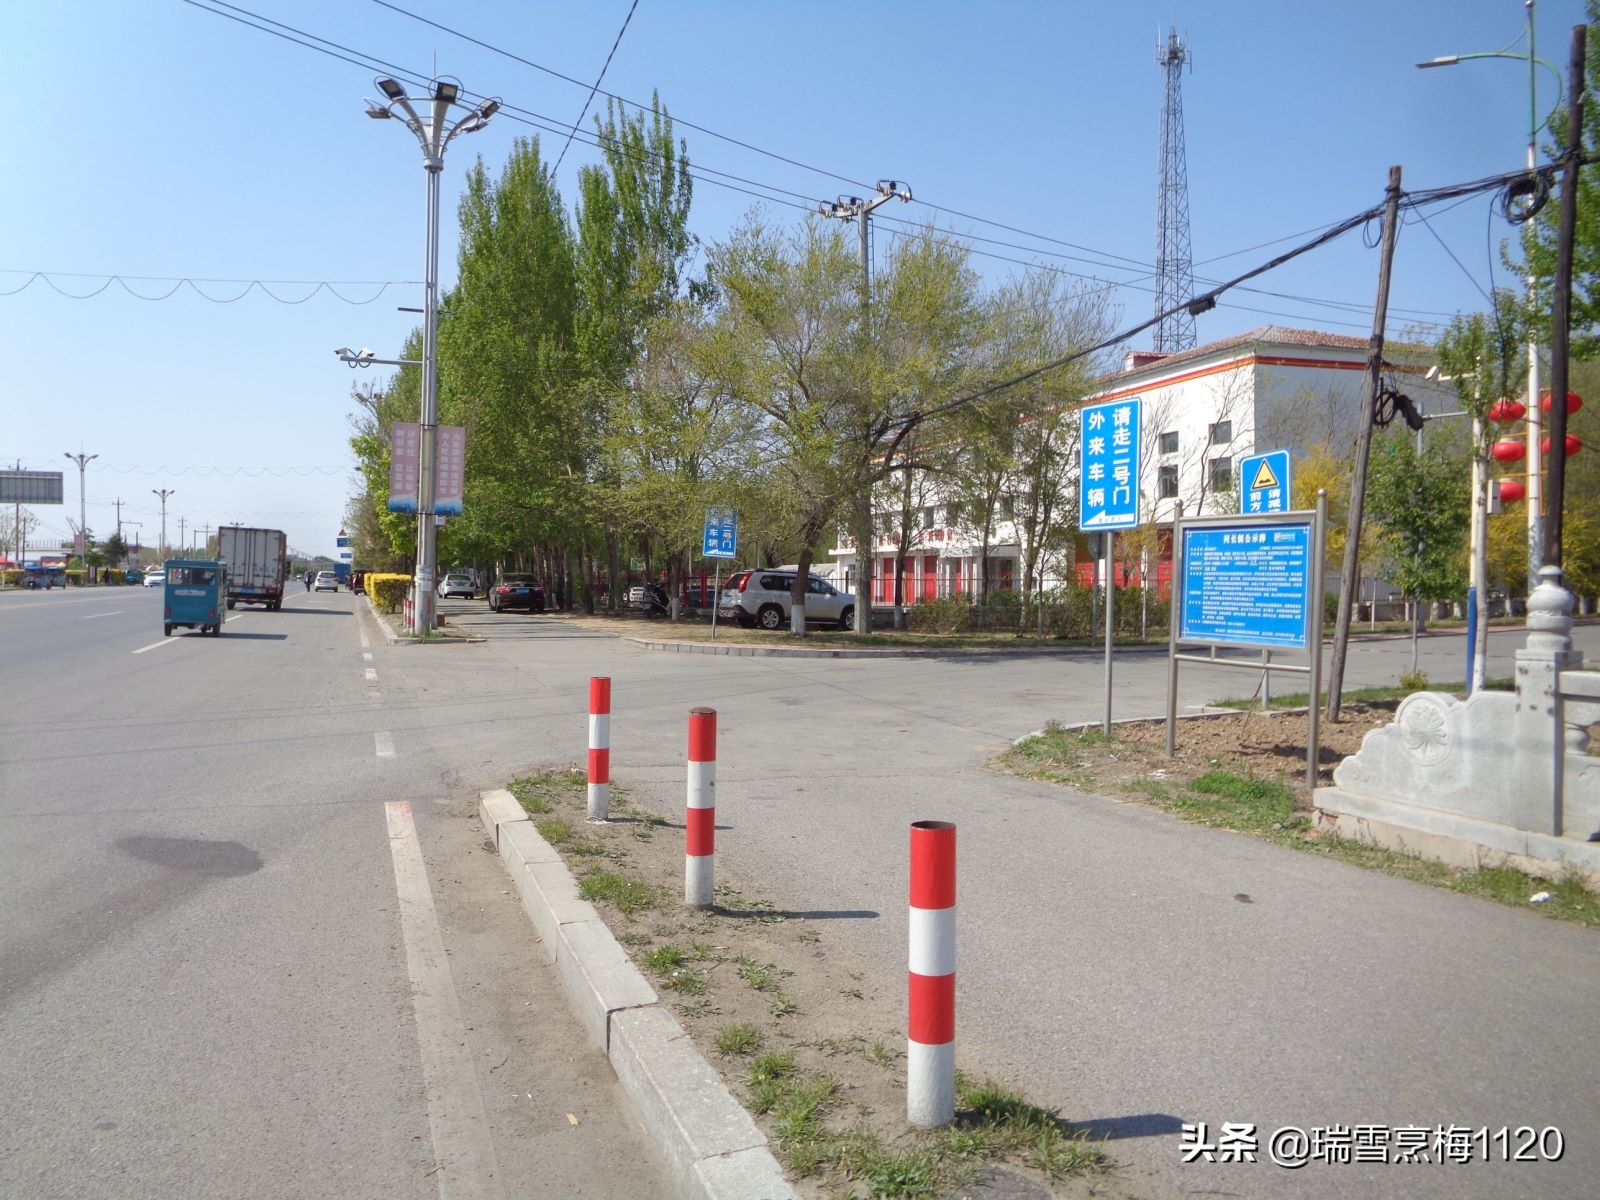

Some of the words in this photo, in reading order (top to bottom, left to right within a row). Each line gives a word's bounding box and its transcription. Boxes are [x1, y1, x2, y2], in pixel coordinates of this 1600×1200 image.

[1088, 411, 1104, 507] 外来车辆
[1112, 406, 1131, 505] 请走二号门
[1250, 491, 1261, 513] 前方
[1268, 489, 1280, 512] 请减
